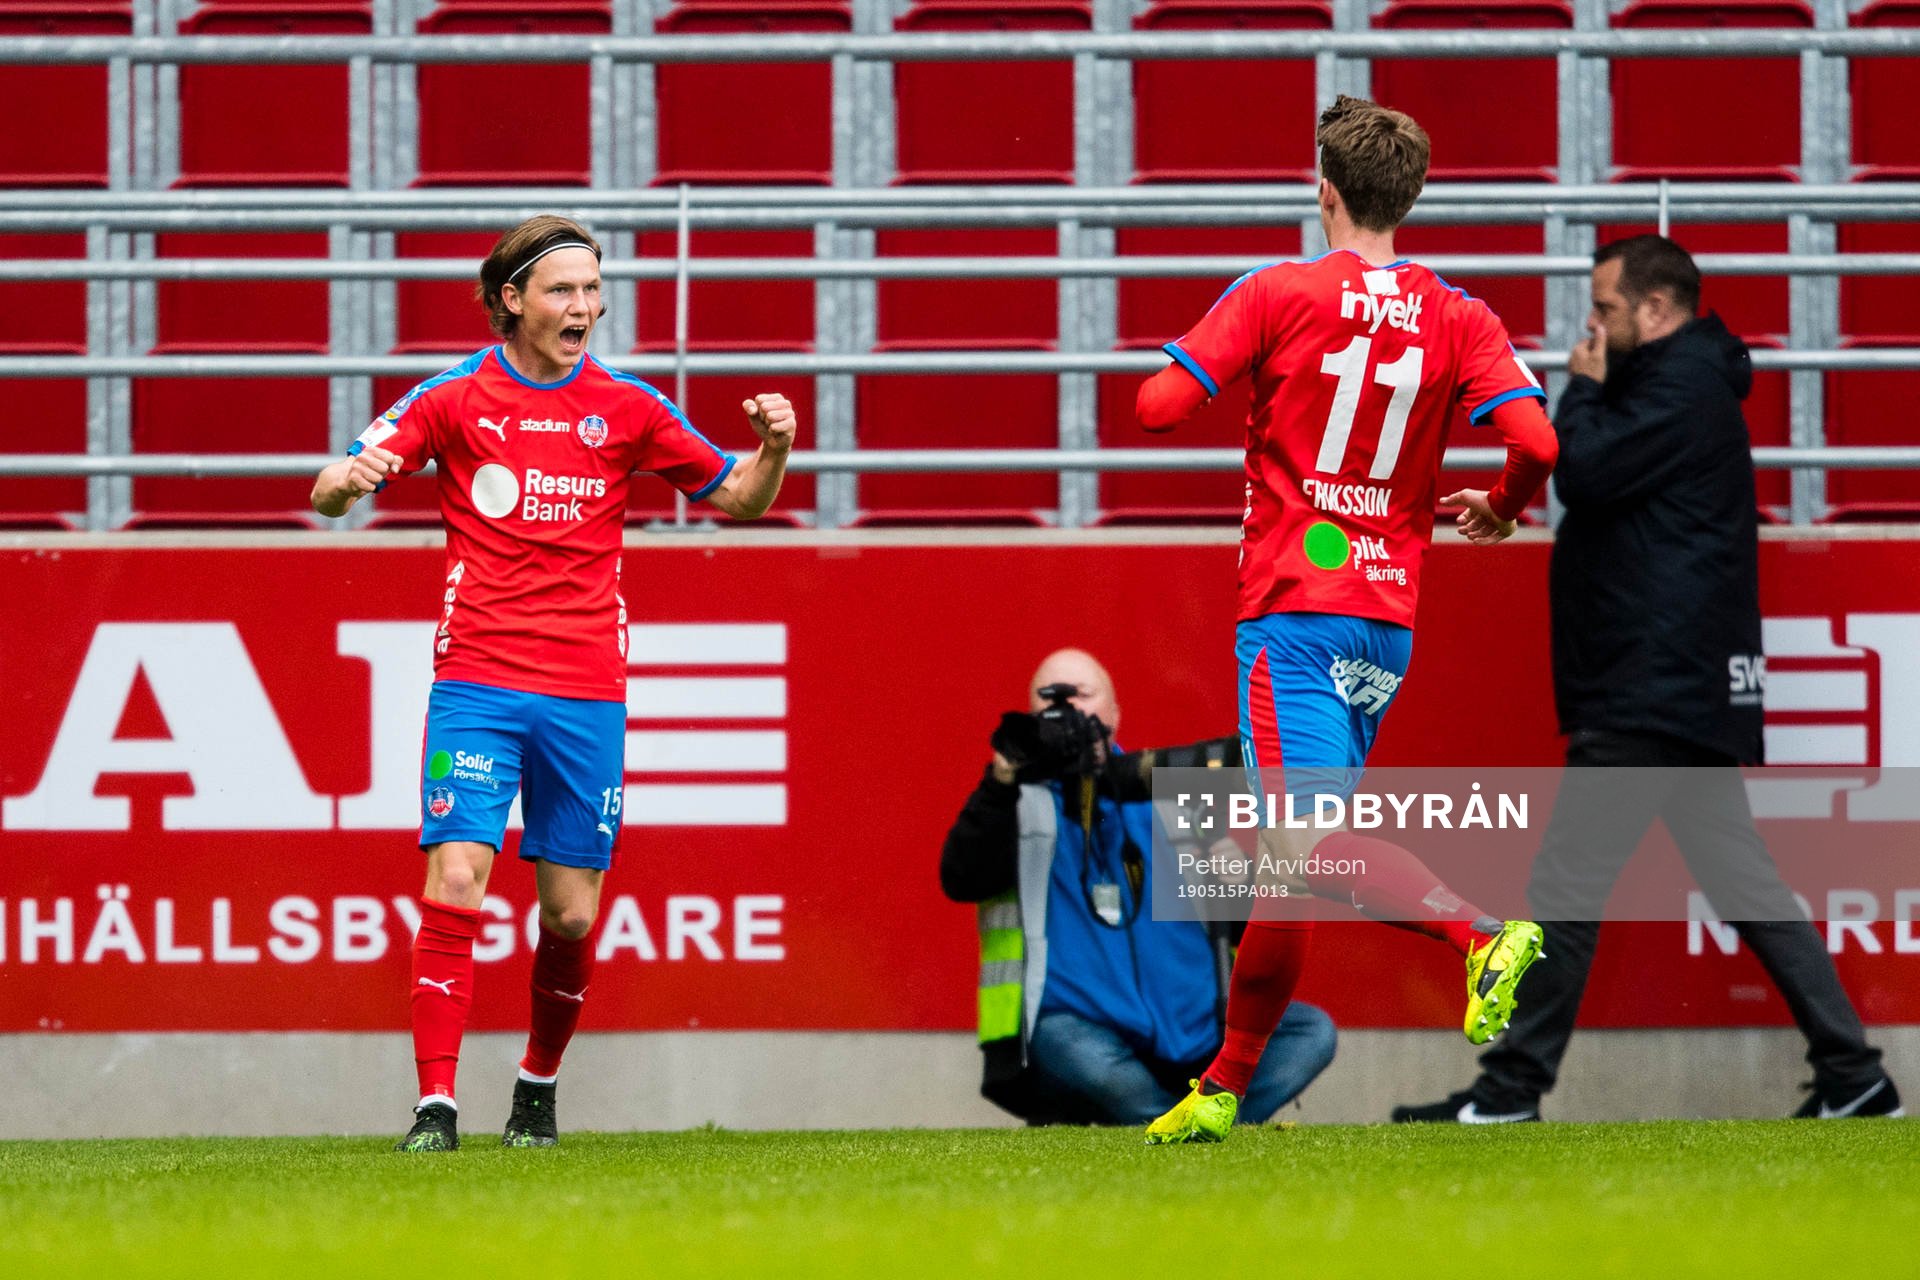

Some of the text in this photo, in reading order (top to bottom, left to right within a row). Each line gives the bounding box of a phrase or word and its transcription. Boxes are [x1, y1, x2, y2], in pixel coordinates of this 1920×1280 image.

[1340, 280, 1423, 334] inyett
[1315, 335, 1424, 480] 11
[519, 418, 570, 433] stadium
[525, 468, 606, 498] Resurs
[522, 496, 583, 522] Bank
[454, 750, 494, 773] Solid
[602, 787, 622, 816] 15
